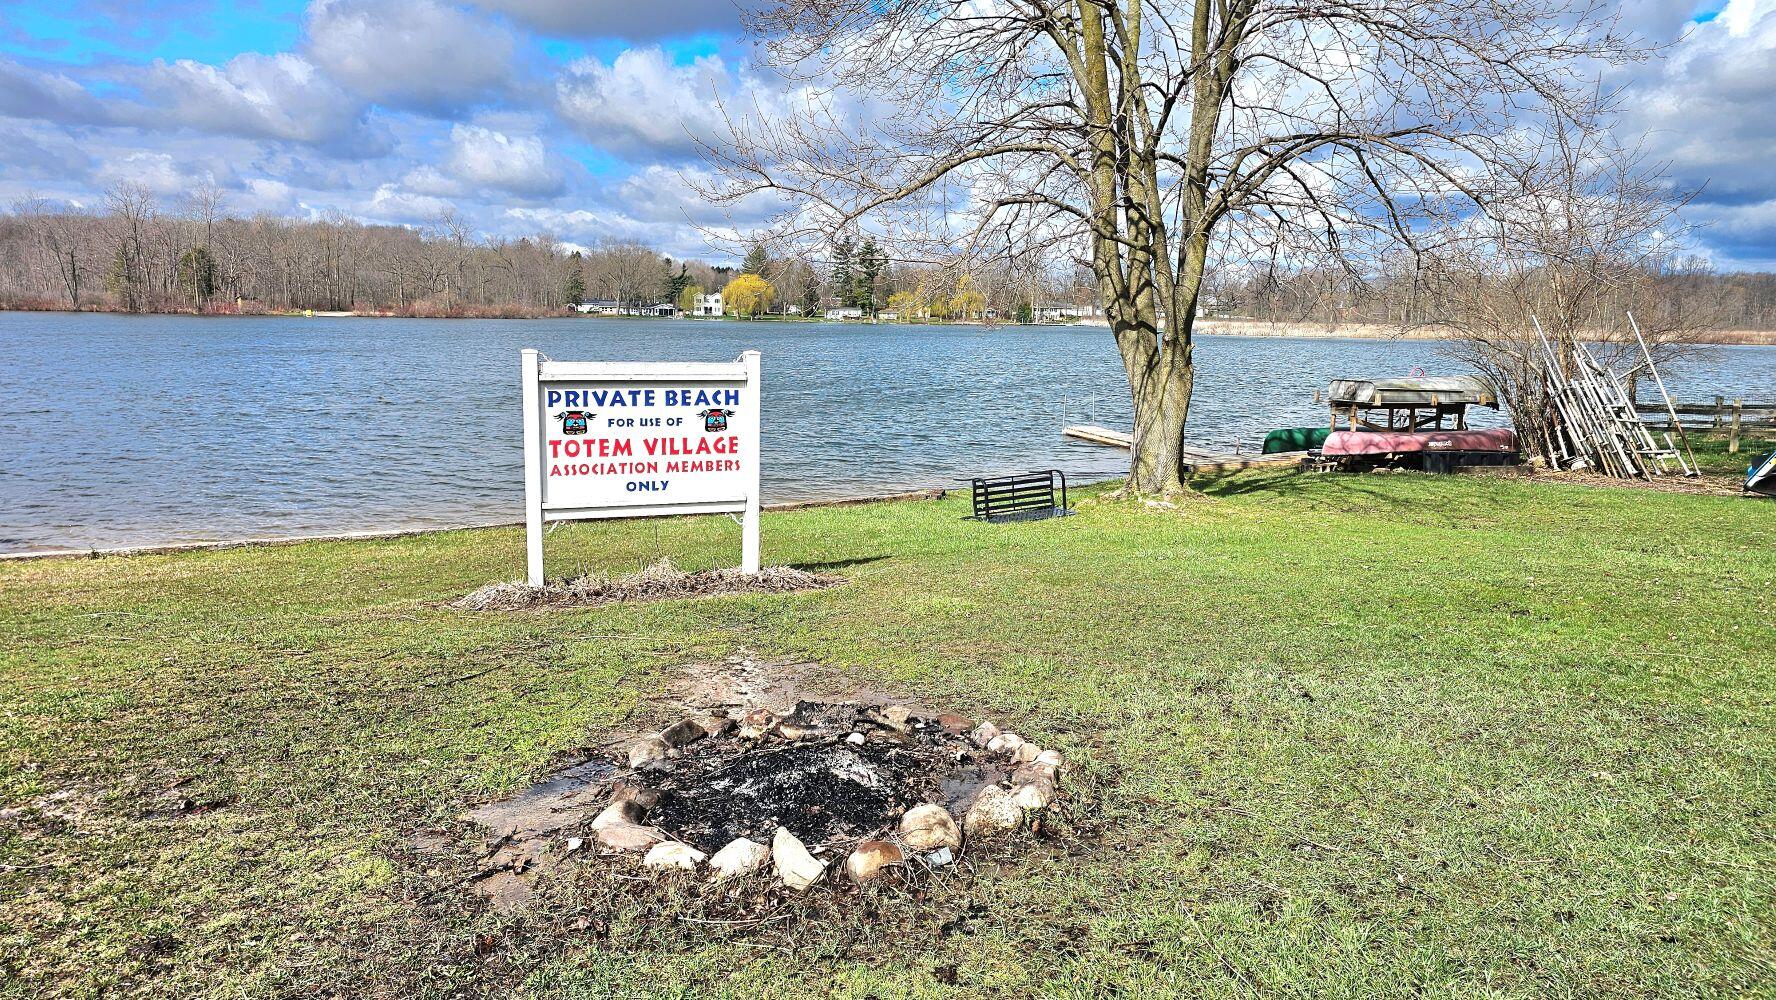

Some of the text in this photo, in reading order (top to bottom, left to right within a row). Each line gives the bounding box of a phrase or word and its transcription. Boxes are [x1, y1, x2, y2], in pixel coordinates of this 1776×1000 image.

[548, 389, 740, 408] PRIVATE BEACH
[608, 417, 683, 428] FOR USE OF
[548, 436, 739, 459] TOTEM VILLAGE
[549, 459, 741, 477] ASSOCIATION MEMBERS
[626, 480, 669, 492] ONLY
